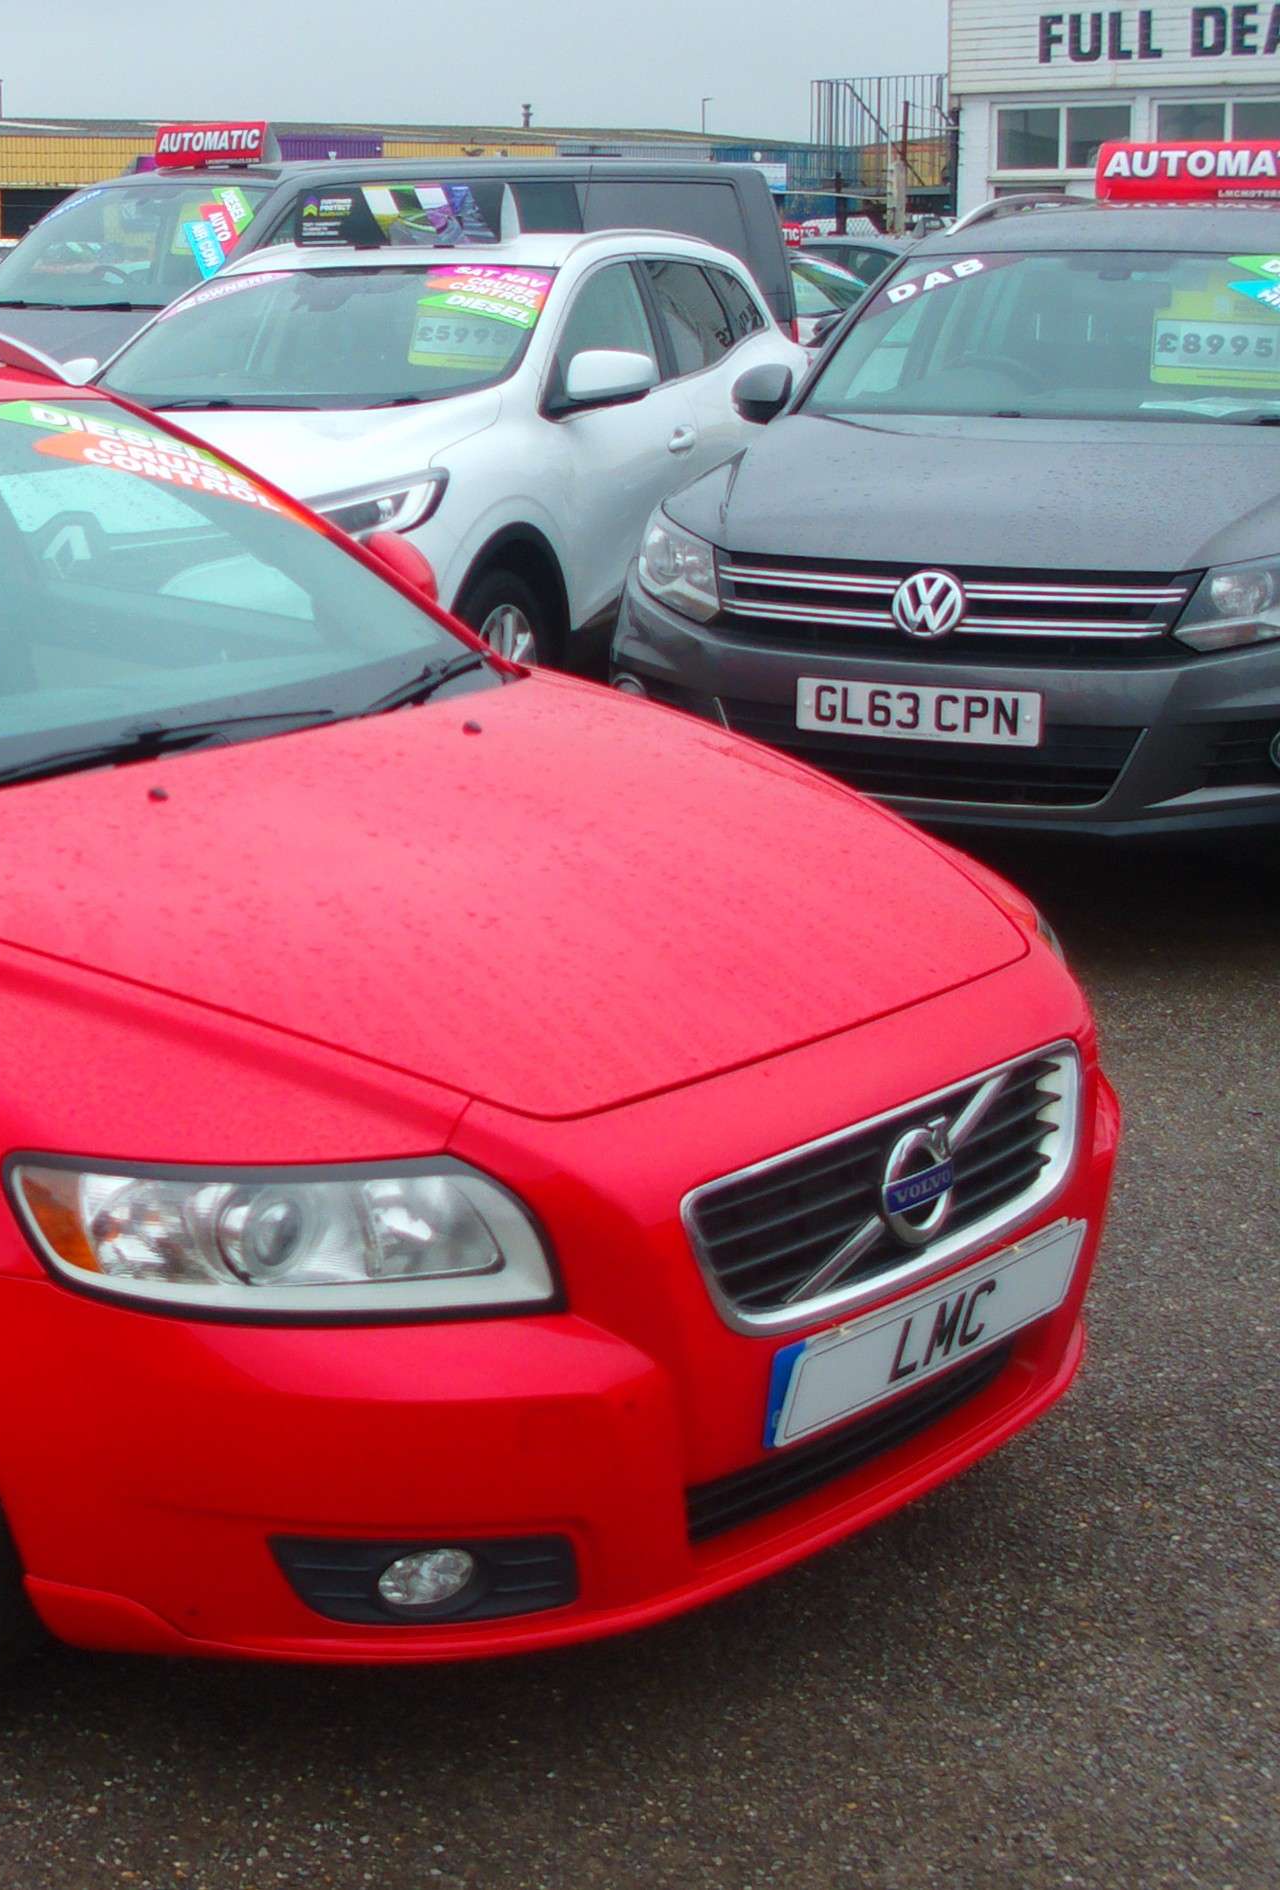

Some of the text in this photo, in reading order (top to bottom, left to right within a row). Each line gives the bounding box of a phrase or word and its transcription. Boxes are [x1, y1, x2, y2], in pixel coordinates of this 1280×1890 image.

[1038, 9, 1163, 64] FULL
[158, 128, 261, 153] AUTOMATIC
[1103, 149, 1280, 178] AUTOMA
[220, 189, 247, 223] DIESEL
[207, 211, 232, 242] AUTO
[453, 266, 548, 288] SAT NAV
[467, 276, 541, 299] CRUISE
[886, 258, 984, 304] DAB
[444, 293, 530, 324] DIESEL
[448, 282, 537, 309] CONTROL
[1157, 332, 1274, 358] £8995
[29, 405, 218, 469] DIESEL
[82, 447, 281, 512] CONTROL
[99, 439, 258, 496] CRUISE
[814, 684, 1019, 737] GL63 CPN
[895, 1168, 952, 1204] VOLVO
[887, 1278, 997, 1384] LMC
